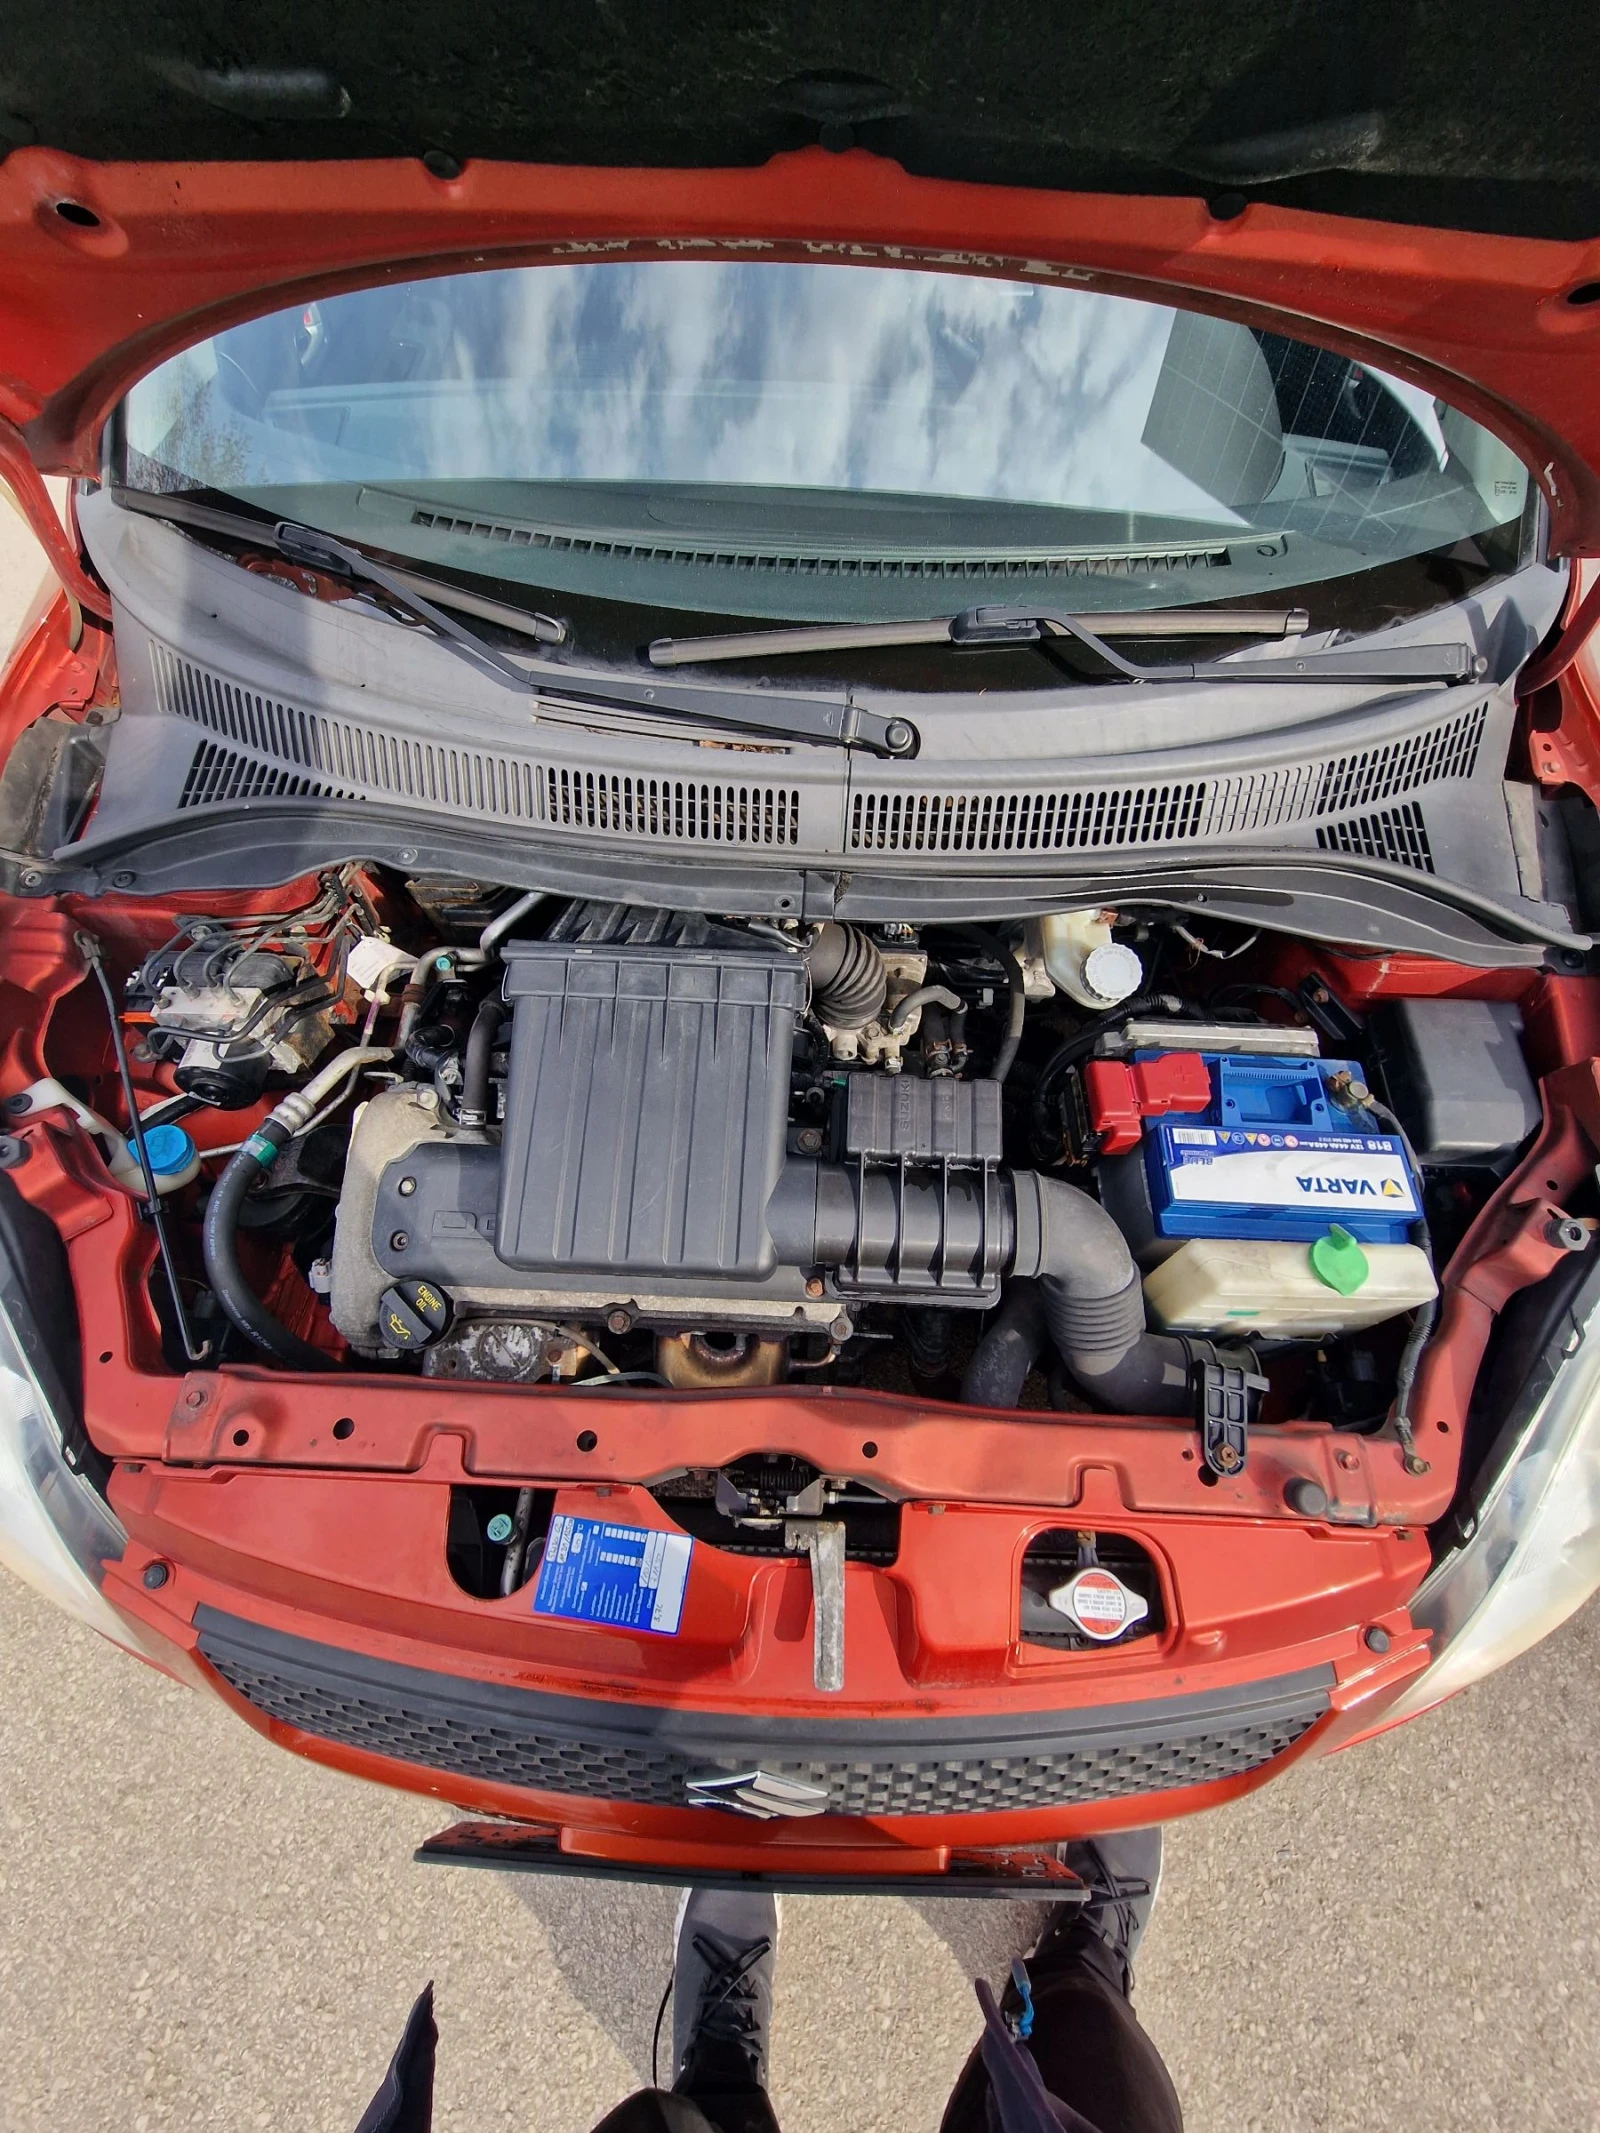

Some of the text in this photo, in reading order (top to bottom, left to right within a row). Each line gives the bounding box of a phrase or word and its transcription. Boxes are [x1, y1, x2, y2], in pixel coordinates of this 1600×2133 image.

[900, 1079, 910, 1132] SUZUKI
[1366, 1140, 1393, 1152] B18
[1182, 1156, 1213, 1165] BLUE
[1296, 1176, 1377, 1196] VARTA
[415, 1297, 428, 1313] OIL
[417, 1285, 442, 1312] ENGINE
